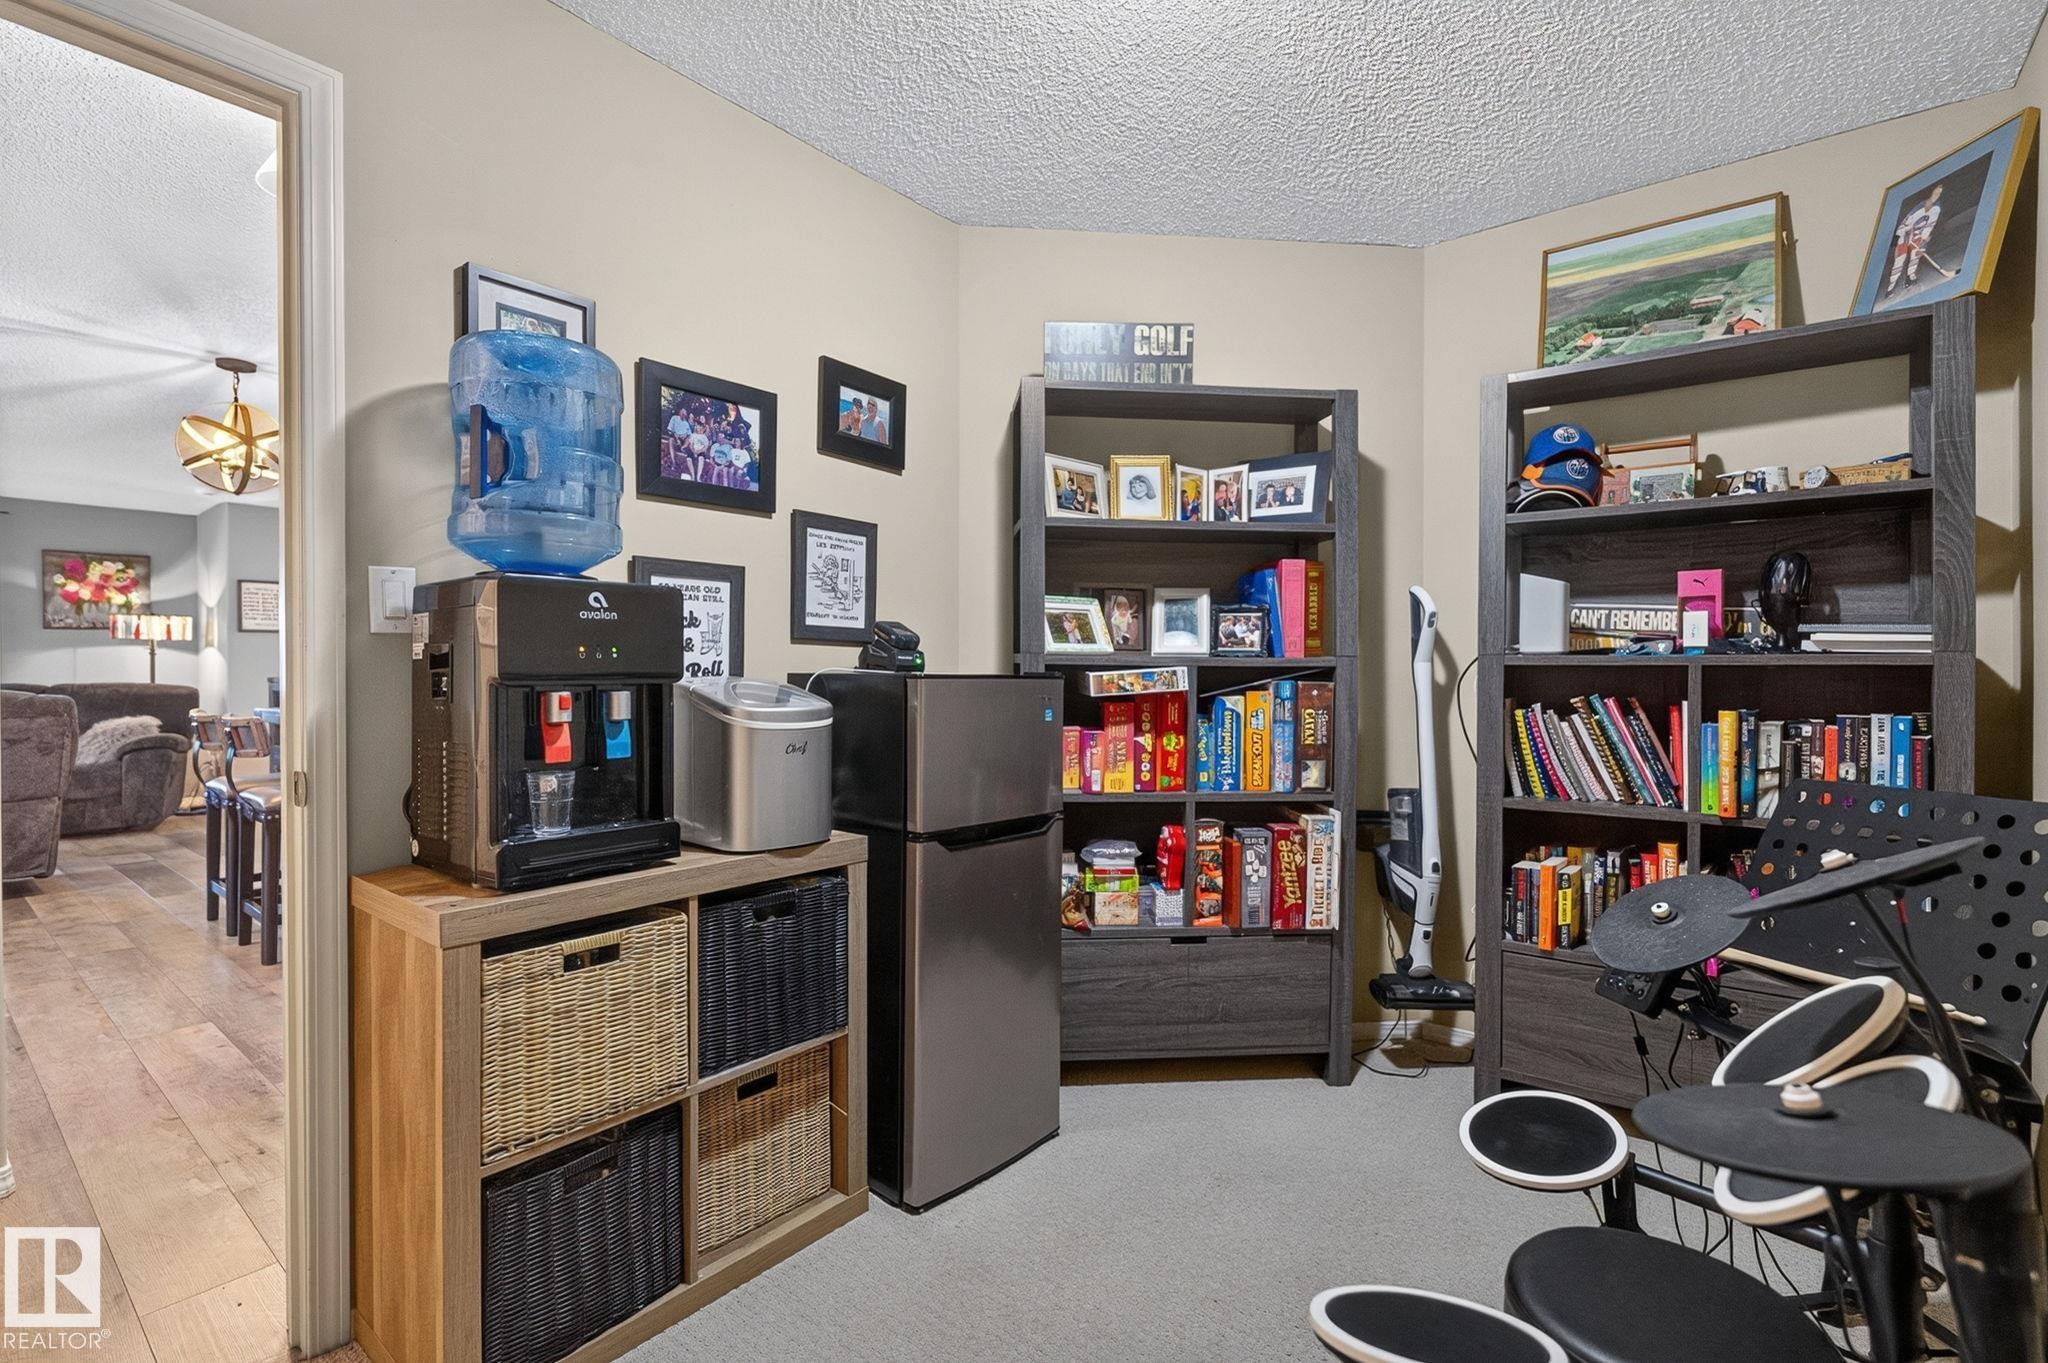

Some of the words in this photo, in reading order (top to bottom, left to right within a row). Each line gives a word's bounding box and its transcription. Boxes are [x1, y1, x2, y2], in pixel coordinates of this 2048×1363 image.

[1059, 324, 1127, 355] ONLY
[1134, 325, 1193, 356] GOLF
[1063, 361, 1097, 381] DAYS
[1100, 362, 1129, 382] THAT
[1134, 362, 1156, 383] END
[703, 585, 721, 594] OLD
[579, 608, 618, 620] avalon
[1570, 608, 1610, 629] CAN'T
[1610, 610, 1678, 632] REMEMBE
[686, 660, 724, 678] Roll
[1304, 708, 1315, 745] CATAN
[1252, 733, 1263, 755] OUT
[1252, 756, 1263, 786] SPEAK
[1277, 840, 1303, 909] Yahtzee
[1311, 879, 1324, 916] TICKET
